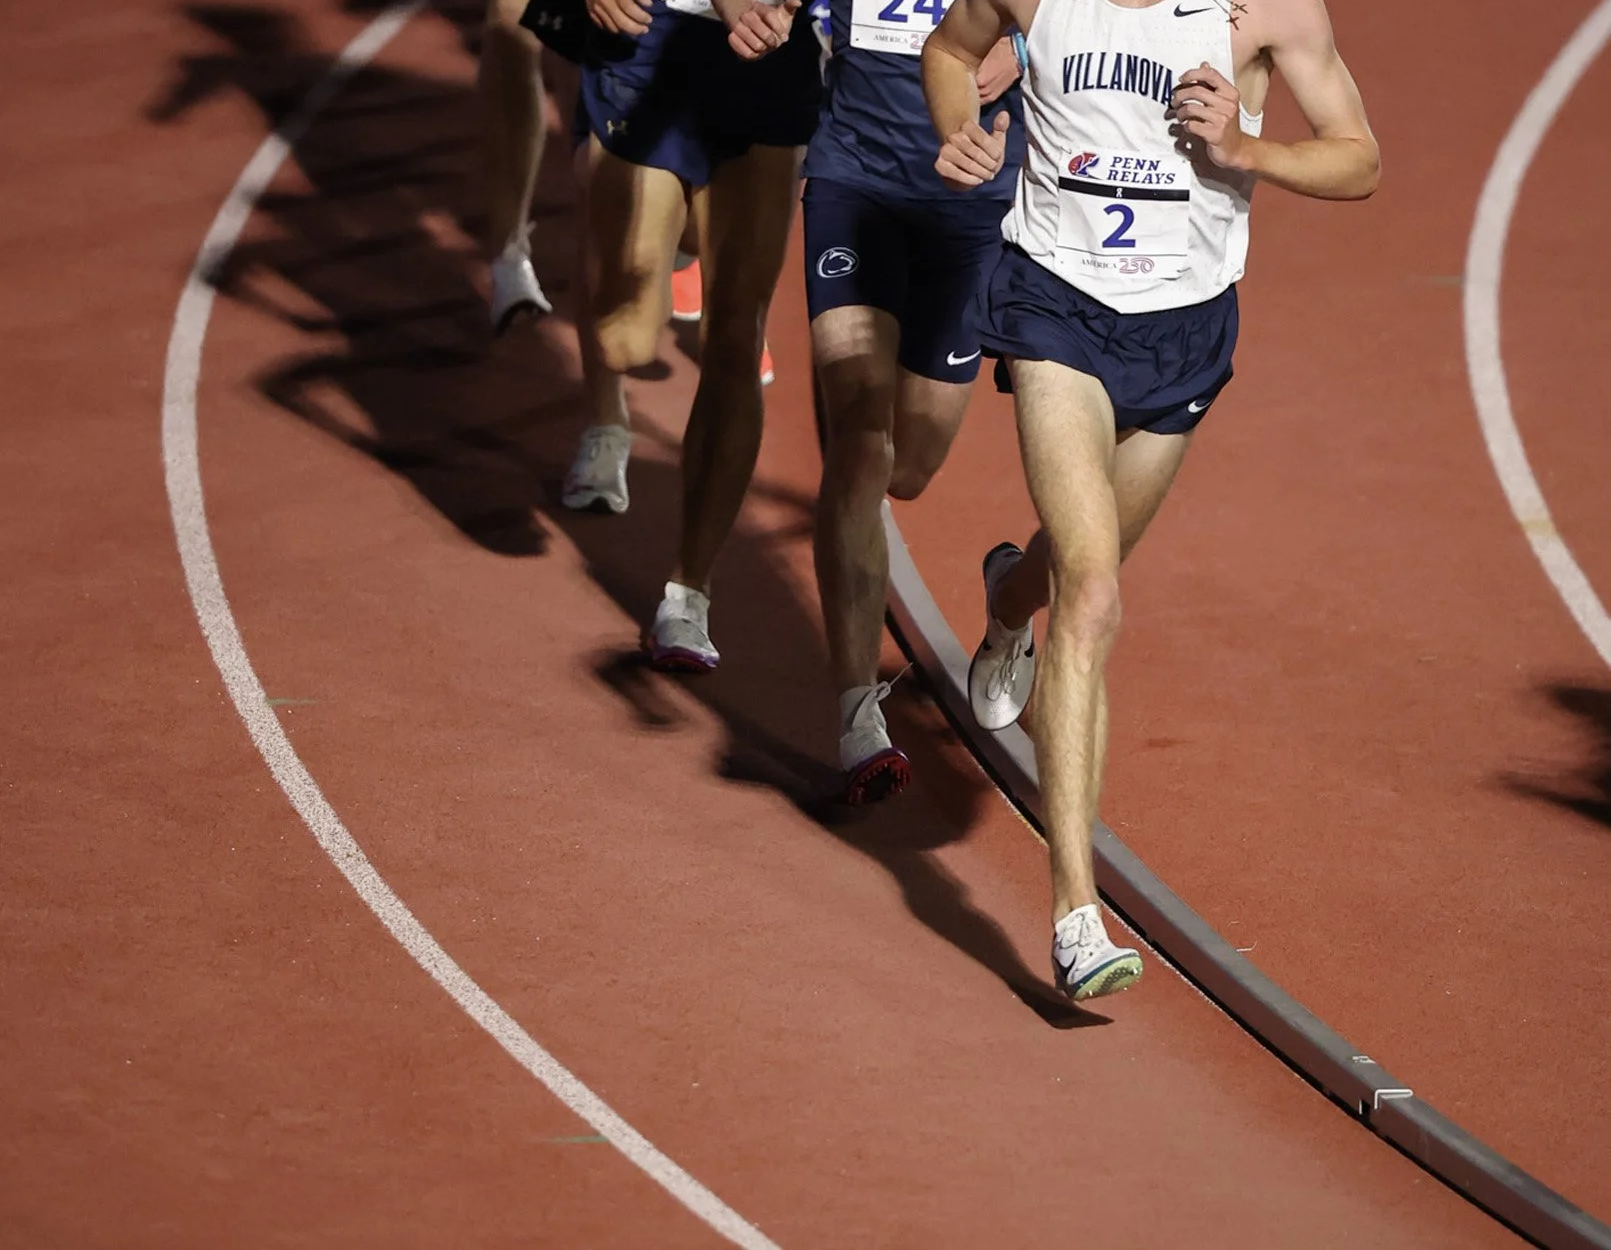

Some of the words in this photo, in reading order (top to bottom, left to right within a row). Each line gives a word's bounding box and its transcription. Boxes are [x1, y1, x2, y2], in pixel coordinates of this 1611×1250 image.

[1111, 156, 1161, 171] PENN
[1107, 169, 1176, 184] RELAYS
[1102, 204, 1136, 248] 2
[1081, 258, 1117, 269] AMERICA
[1119, 256, 1155, 274] 250
